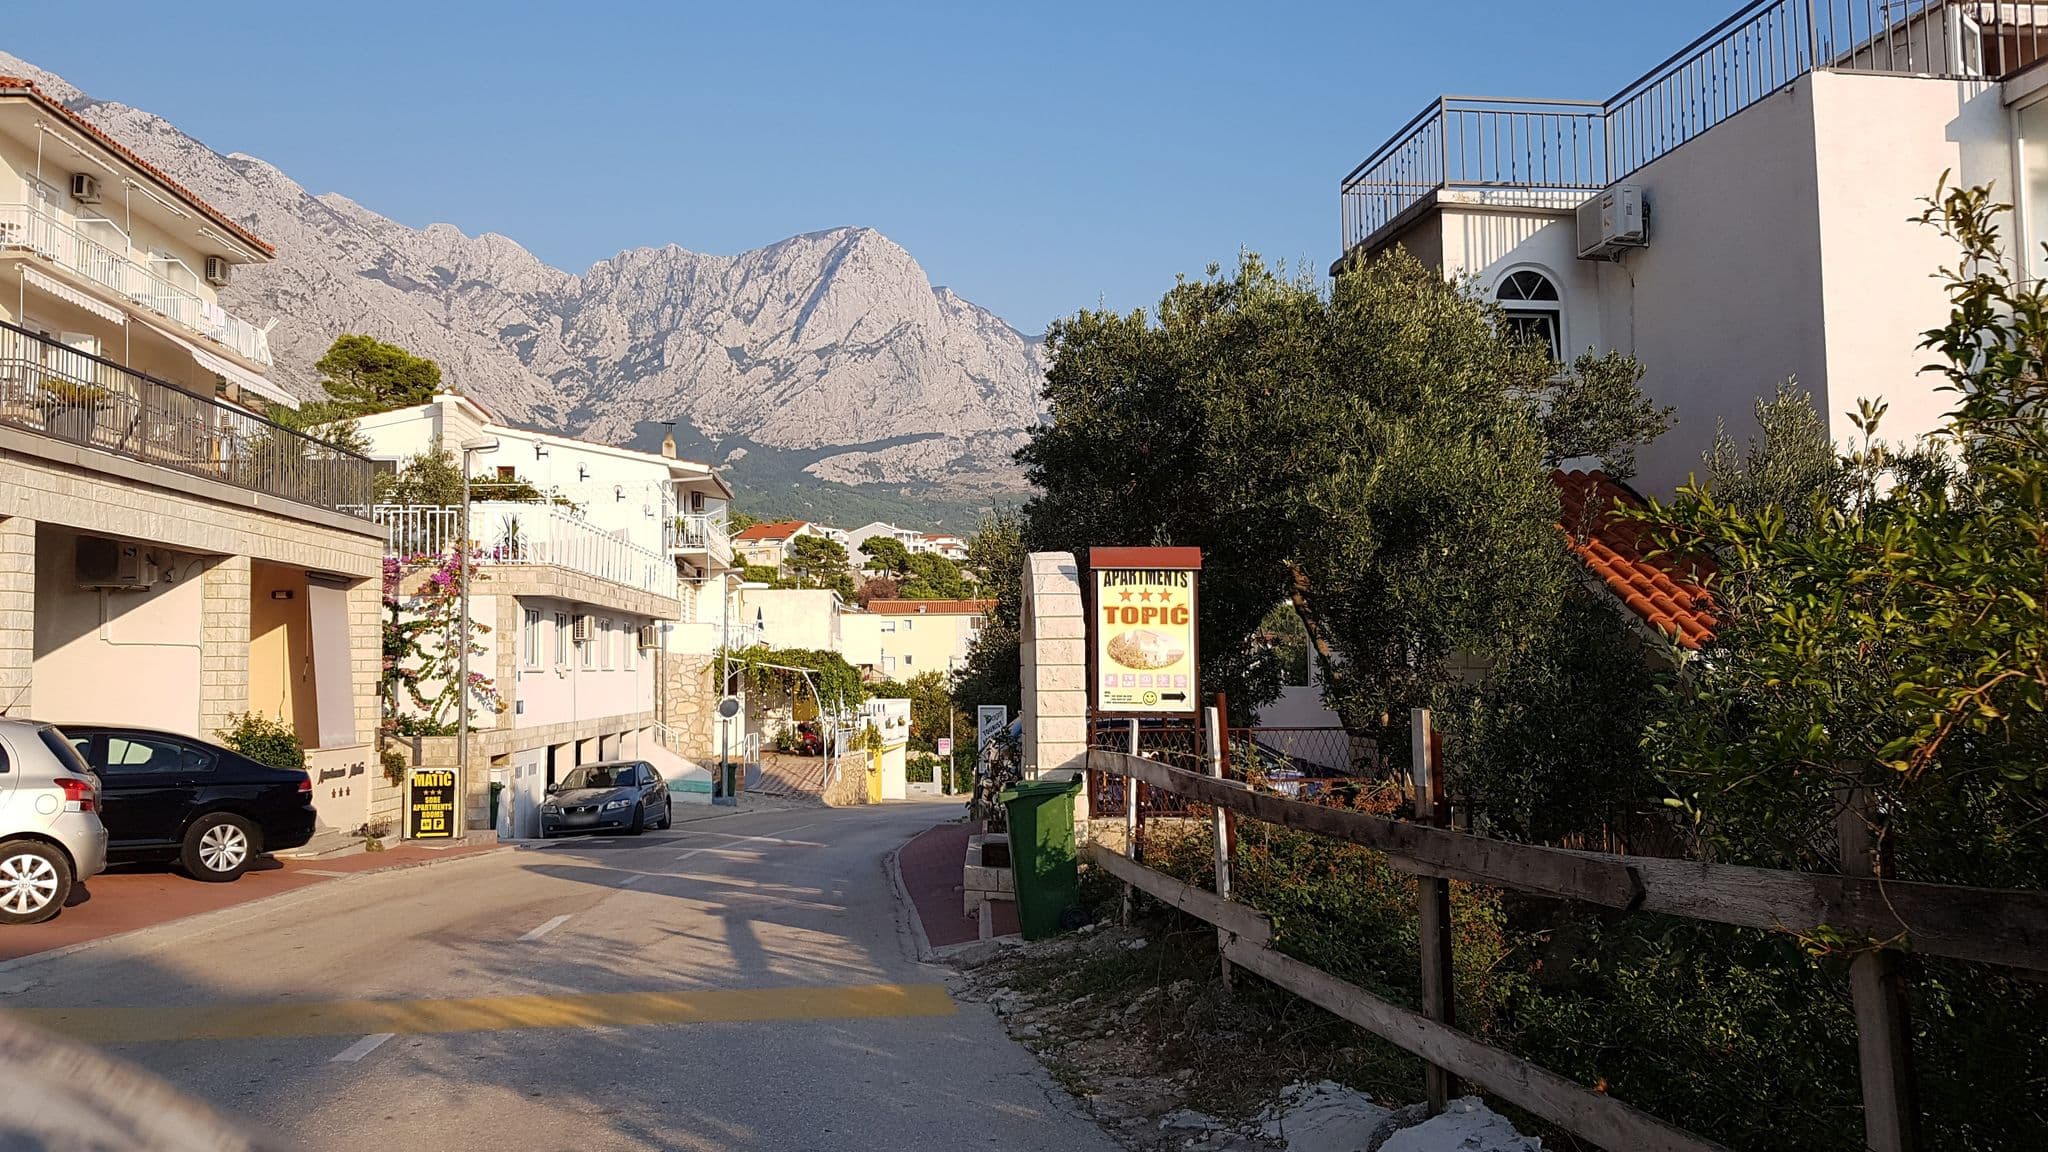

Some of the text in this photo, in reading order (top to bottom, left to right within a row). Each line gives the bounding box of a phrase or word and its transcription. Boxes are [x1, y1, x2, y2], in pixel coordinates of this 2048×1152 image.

[1103, 570, 1188, 588] APARTMENTS
[1103, 603, 1189, 625] TOPIĆ
[413, 803, 453, 811] APARTMENTS
